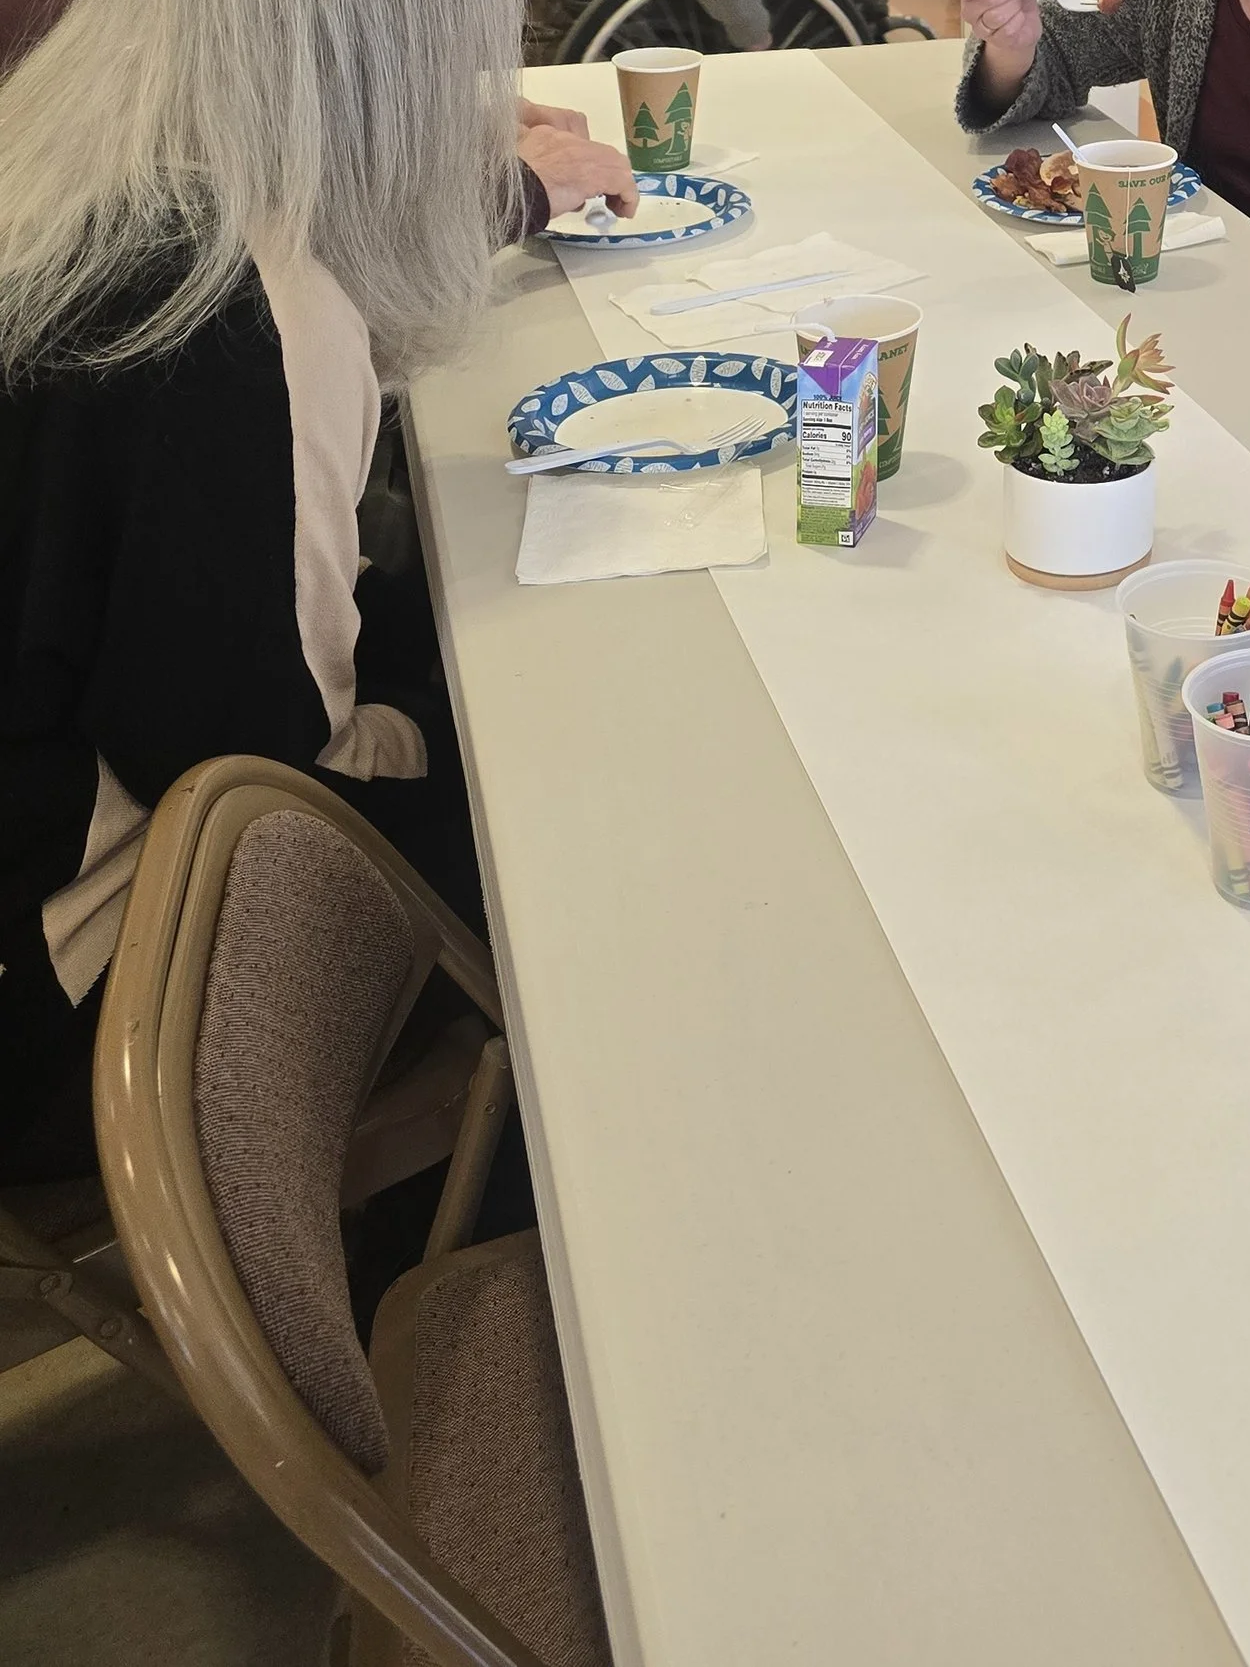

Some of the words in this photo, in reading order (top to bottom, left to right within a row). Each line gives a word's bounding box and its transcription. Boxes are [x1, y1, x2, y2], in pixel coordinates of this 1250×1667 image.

[1118, 178, 1146, 188] SAVE
[878, 342, 909, 361] ANET
[803, 401, 832, 410] Nutrition
[834, 402, 852, 412] Facts
[802, 431, 827, 439] Calories
[841, 432, 852, 441] 90
